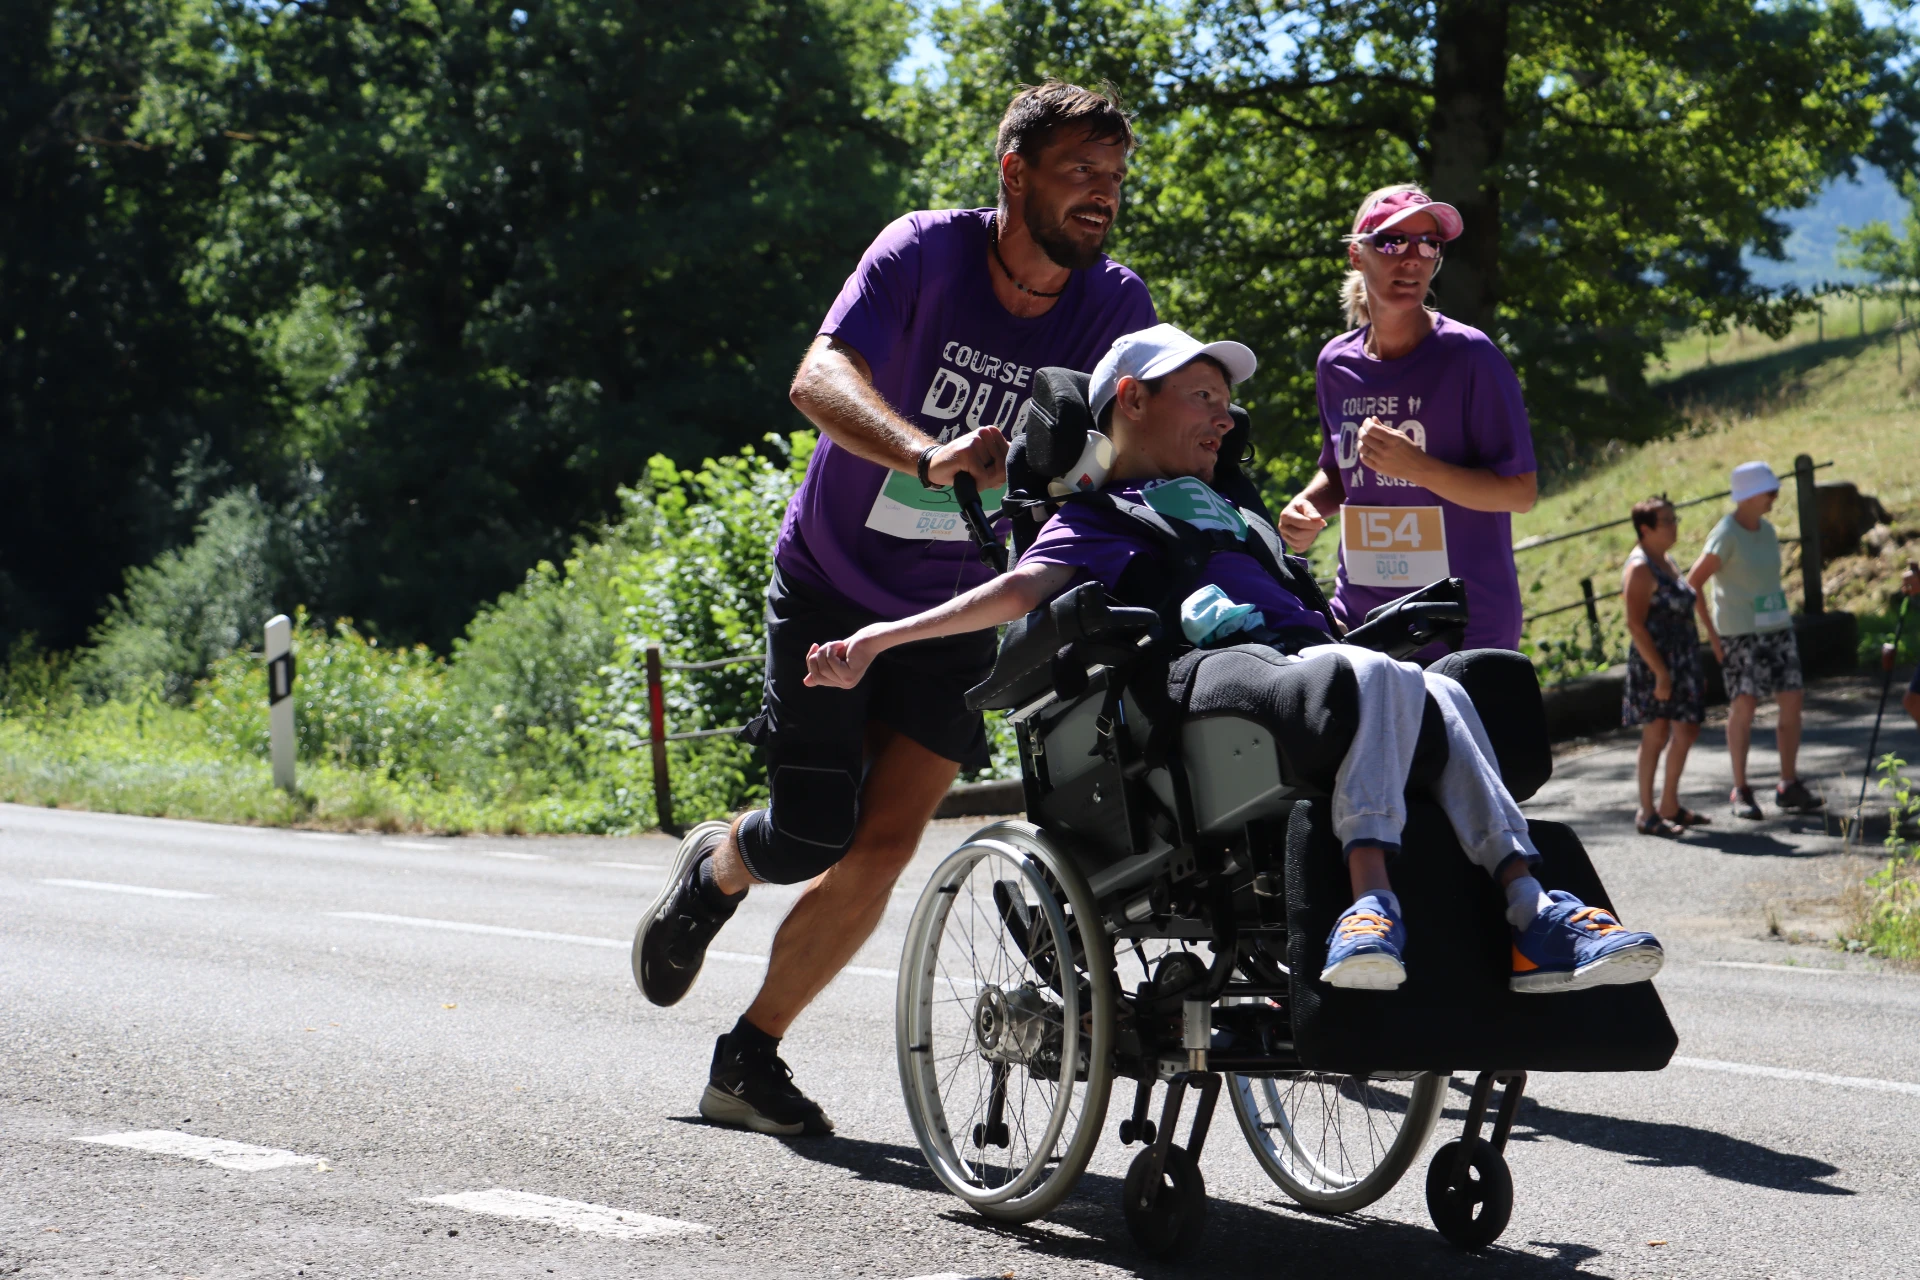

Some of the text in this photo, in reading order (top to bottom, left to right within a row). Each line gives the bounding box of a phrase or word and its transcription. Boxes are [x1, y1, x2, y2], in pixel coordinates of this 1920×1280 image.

[943, 341, 1032, 388] COURSE
[1342, 396, 1399, 416] COURSE
[916, 517, 957, 530] DUO
[1358, 512, 1422, 548] 154
[1376, 560, 1409, 575] DUO
